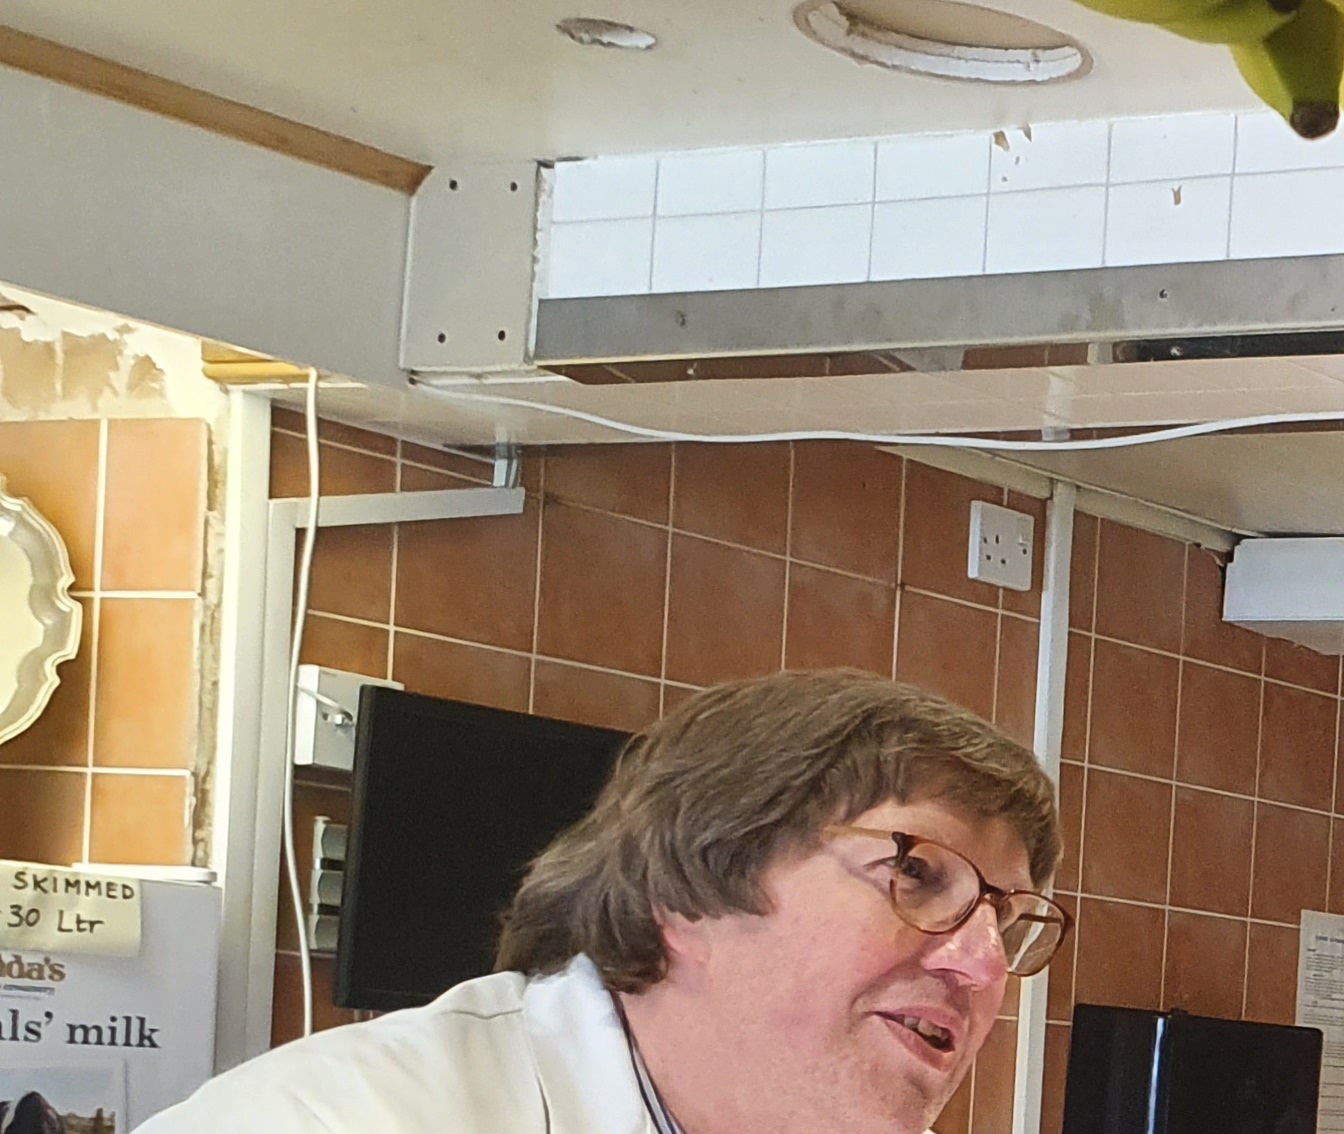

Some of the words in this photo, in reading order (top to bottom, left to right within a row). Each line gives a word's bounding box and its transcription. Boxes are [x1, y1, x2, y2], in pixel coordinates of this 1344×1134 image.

[13, 871, 135, 900] SKIMMED
[7, 904, 41, 927] 30
[57, 910, 104, 933] Ltr
[66, 1015, 160, 1049] milk
